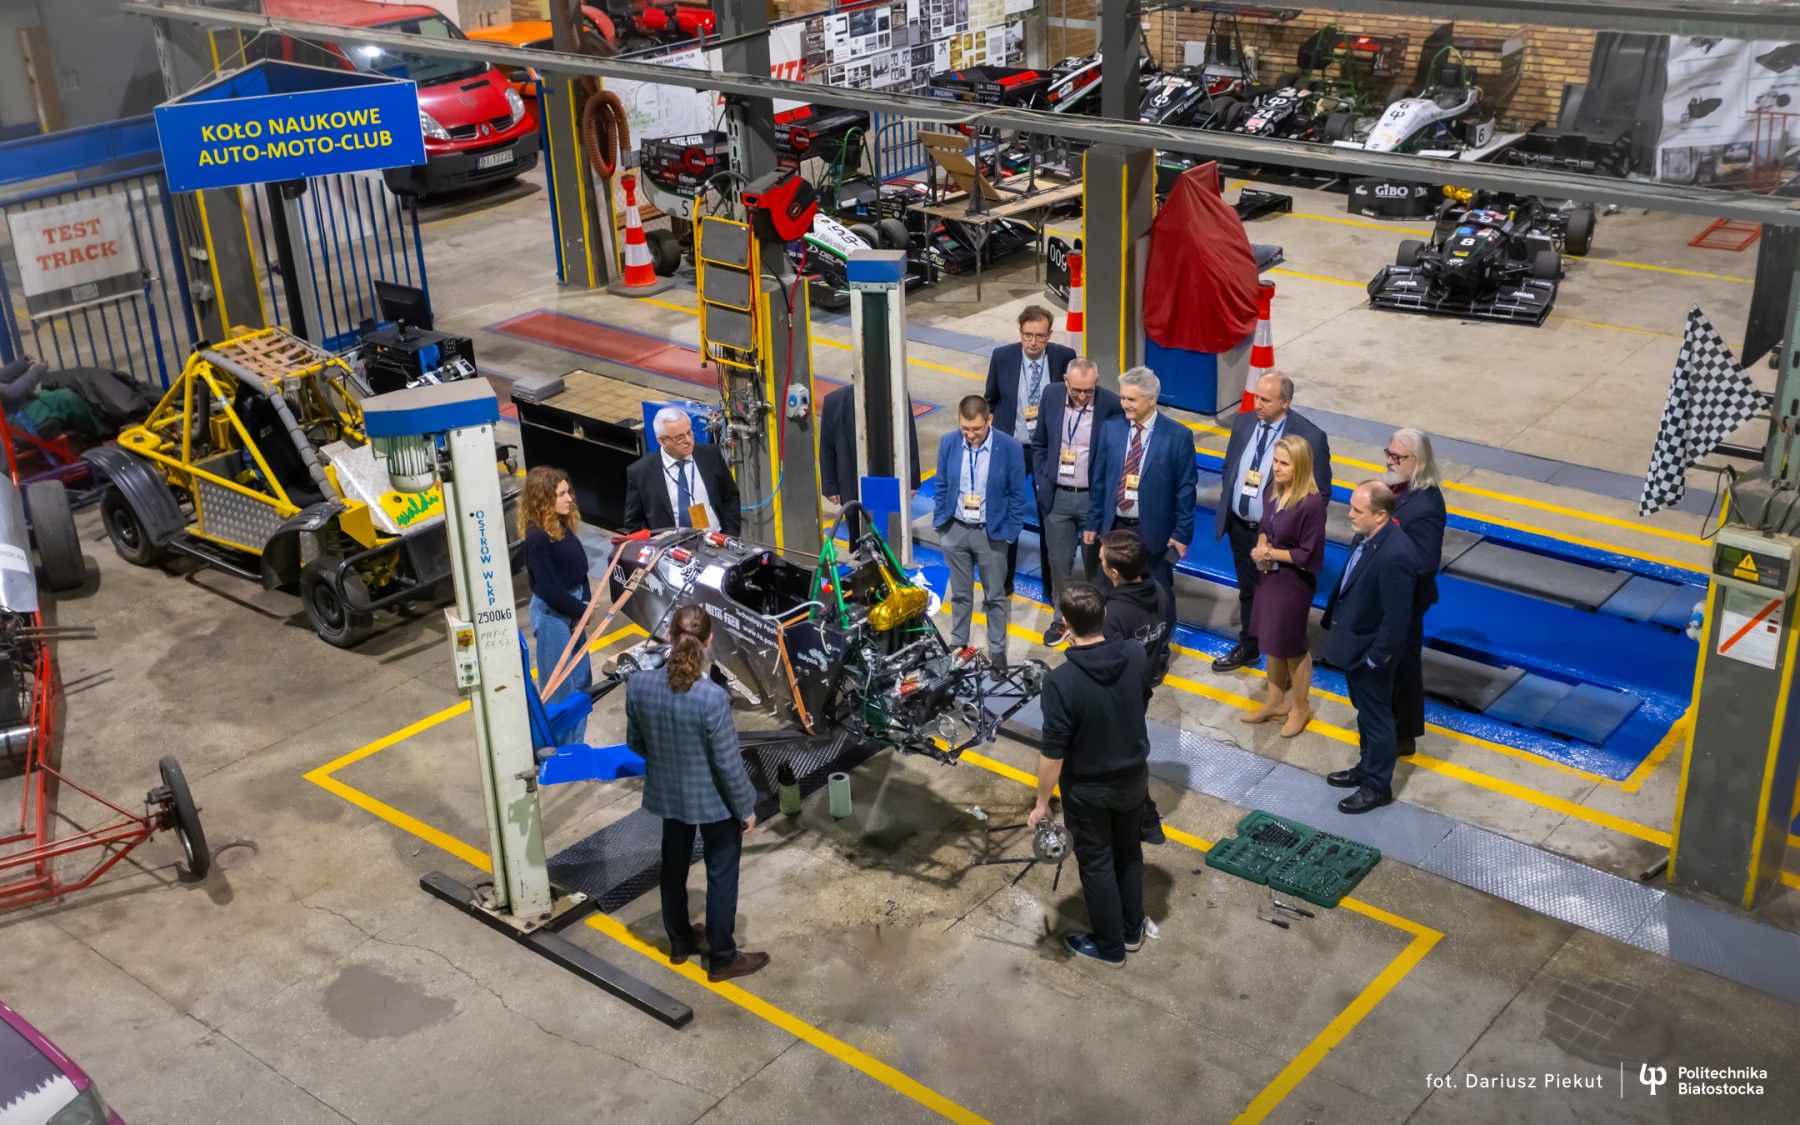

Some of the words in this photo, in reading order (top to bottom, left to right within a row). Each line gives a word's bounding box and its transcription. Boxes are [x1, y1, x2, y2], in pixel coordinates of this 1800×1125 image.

[770, 58, 807, 82] ITE
[201, 120, 263, 143] KOŁO
[268, 107, 382, 136] NAUKOWE
[1252, 109, 1275, 119] 24
[1478, 128, 1486, 143] 6
[198, 130, 393, 167] AUTO-MOTO-CLUB
[682, 200, 690, 217] 5
[42, 219, 101, 245] TEST
[1460, 238, 1476, 246] 8
[36, 240, 118, 271] TRACK
[1050, 243, 1067, 272] 009
[482, 571, 496, 606] WLKP
[477, 608, 512, 624] 2500kG
